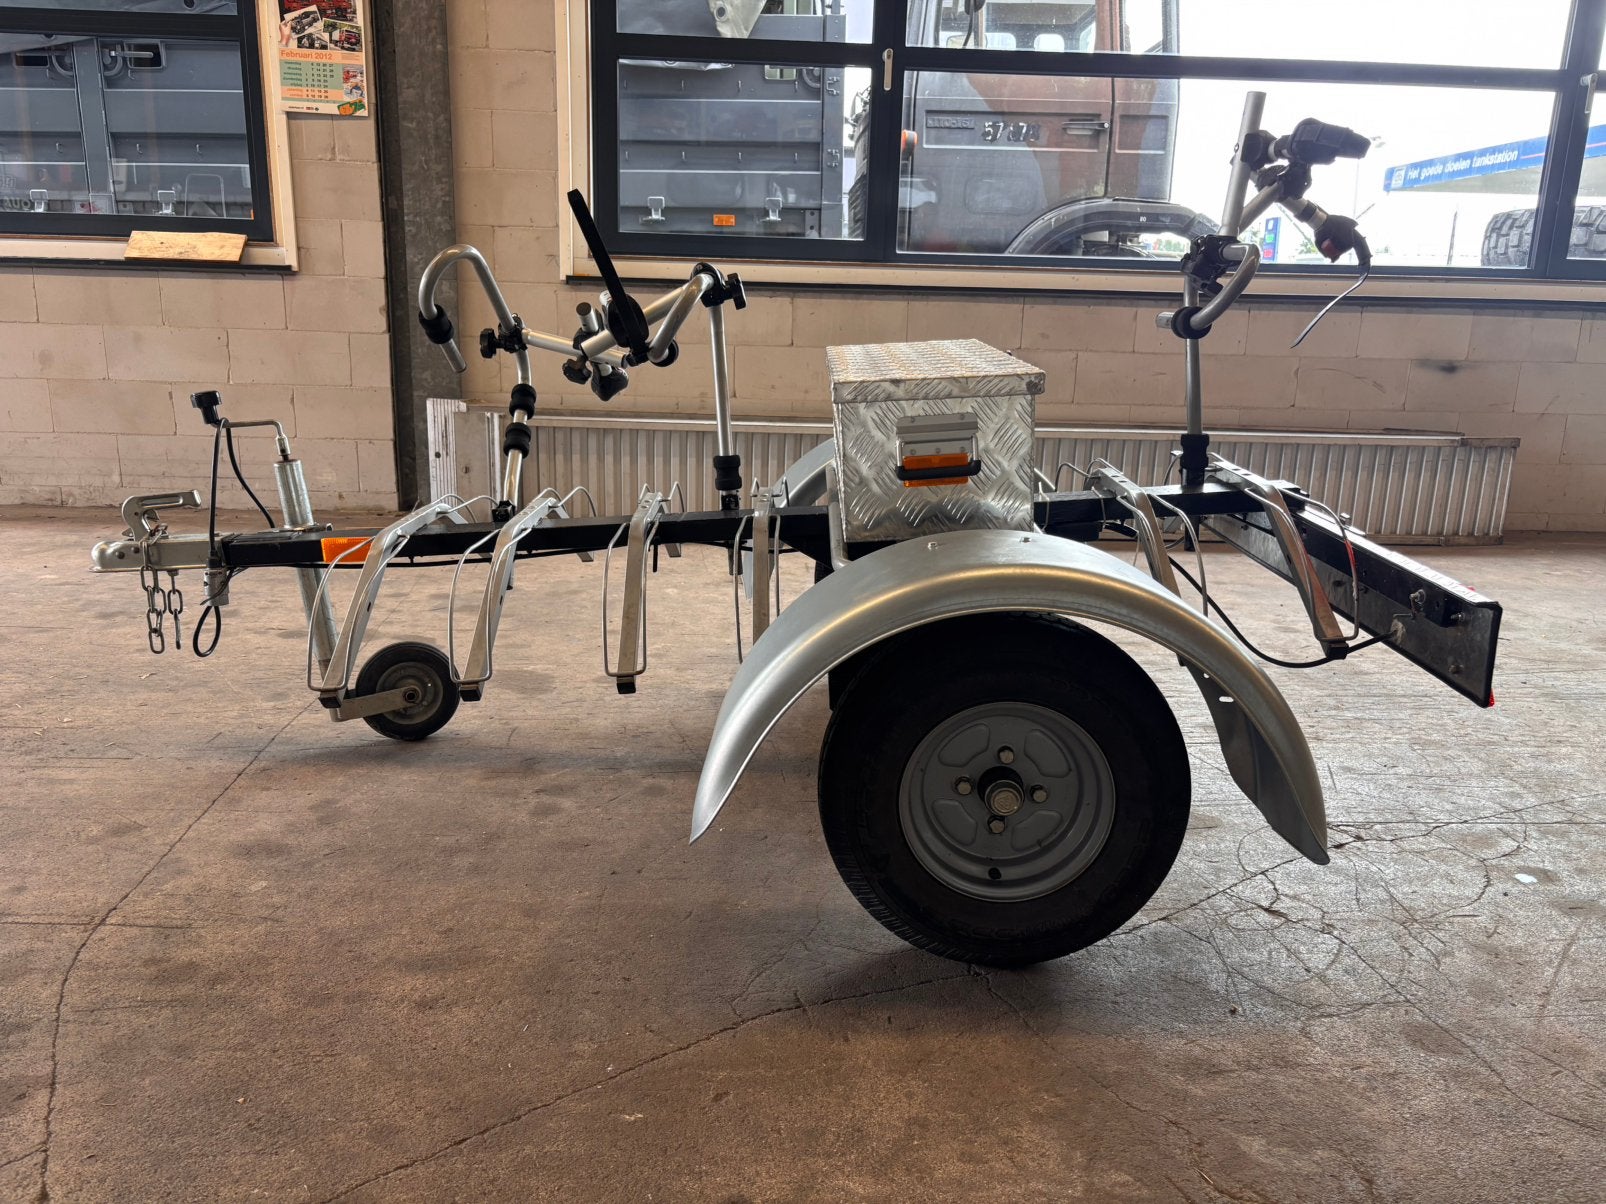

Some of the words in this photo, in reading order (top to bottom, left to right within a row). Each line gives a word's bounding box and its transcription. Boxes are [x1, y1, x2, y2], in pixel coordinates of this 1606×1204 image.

[281, 49, 313, 59] Februari
[315, 52, 332, 60] 2012
[1408, 167, 1419, 180] Het
[1420, 163, 1443, 180] goede
[1445, 158, 1470, 173] doelen
[1472, 150, 1518, 167] tankstation
